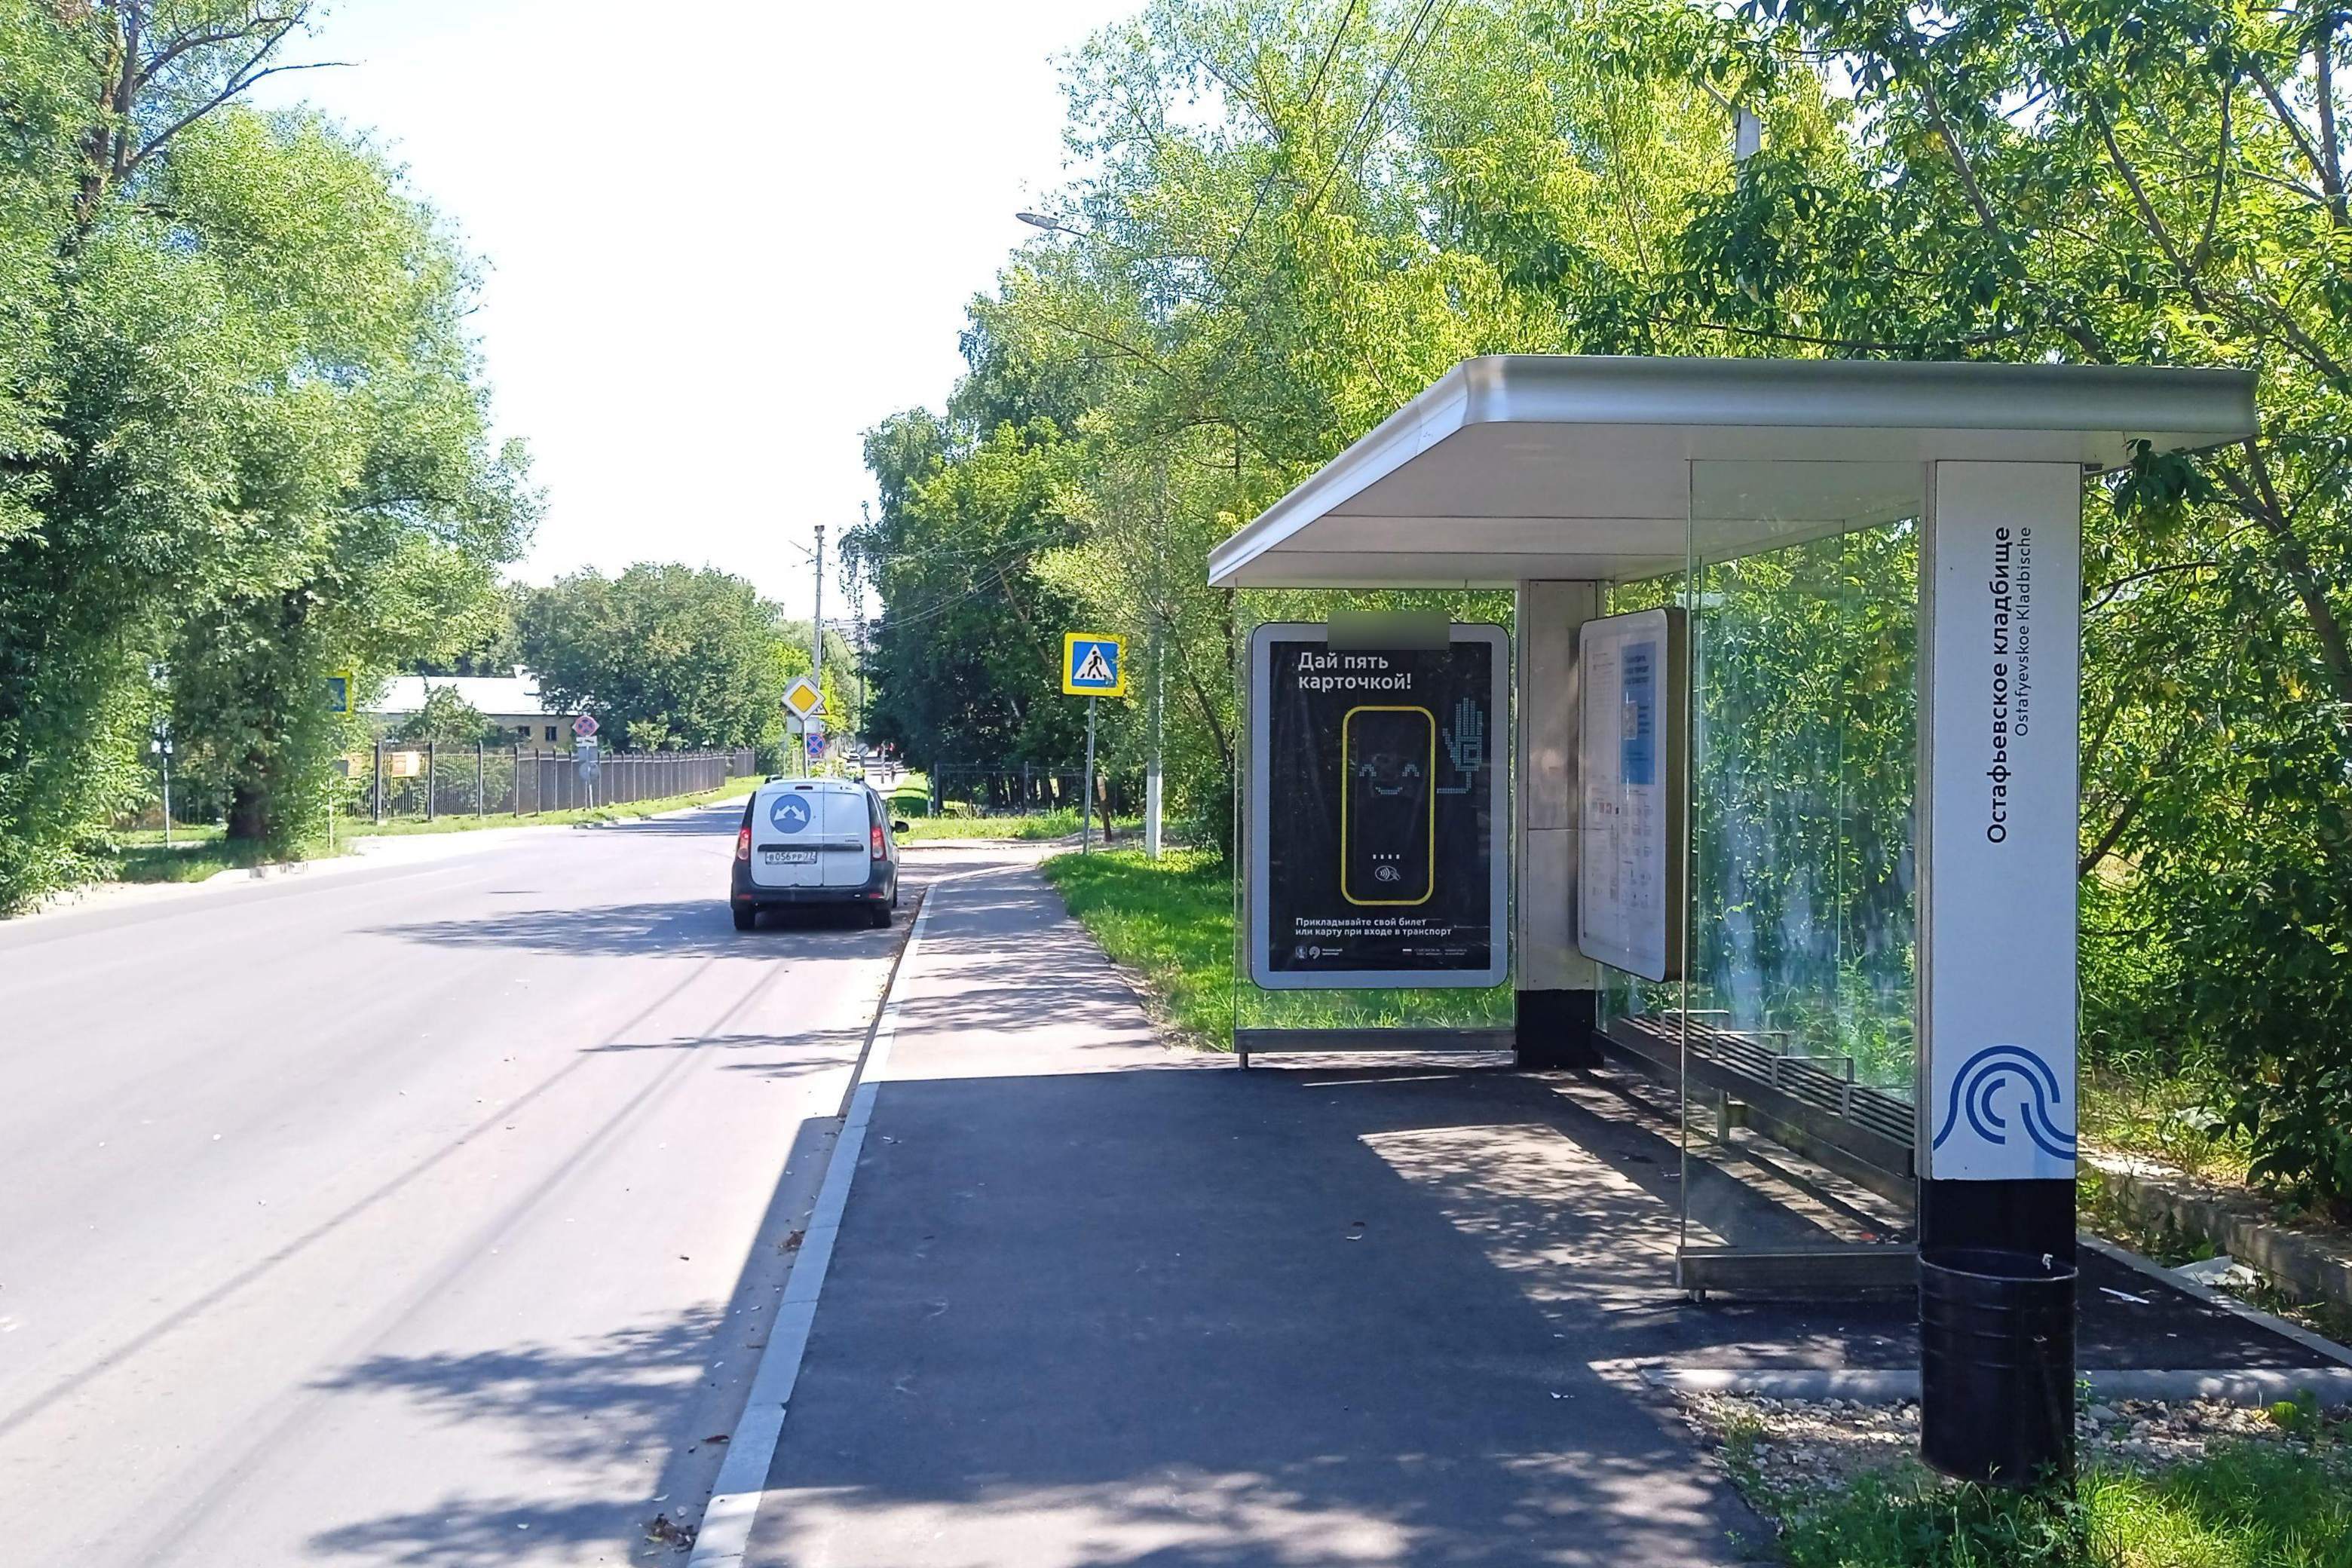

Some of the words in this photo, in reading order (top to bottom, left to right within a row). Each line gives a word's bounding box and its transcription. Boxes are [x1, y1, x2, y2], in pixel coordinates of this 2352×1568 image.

[1989, 527, 2013, 654] кладбище
[2016, 527, 2031, 620] Kladbische
[1298, 652, 1338, 671] Дай
[1345, 656, 1389, 669] пять
[1298, 673, 1412, 693] карточкой!
[2014, 626, 2032, 737] Ostafyevskoe
[1986, 663, 2011, 844] Остафьевское
[1296, 917, 1371, 927] Прикладывайте
[1374, 917, 1396, 926] свой
[1398, 917, 1426, 926] билет
[1315, 928, 1342, 937] карту
[1344, 928, 1361, 937] при
[1364, 928, 1392, 937] входе
[1403, 928, 1452, 937] транспорт
